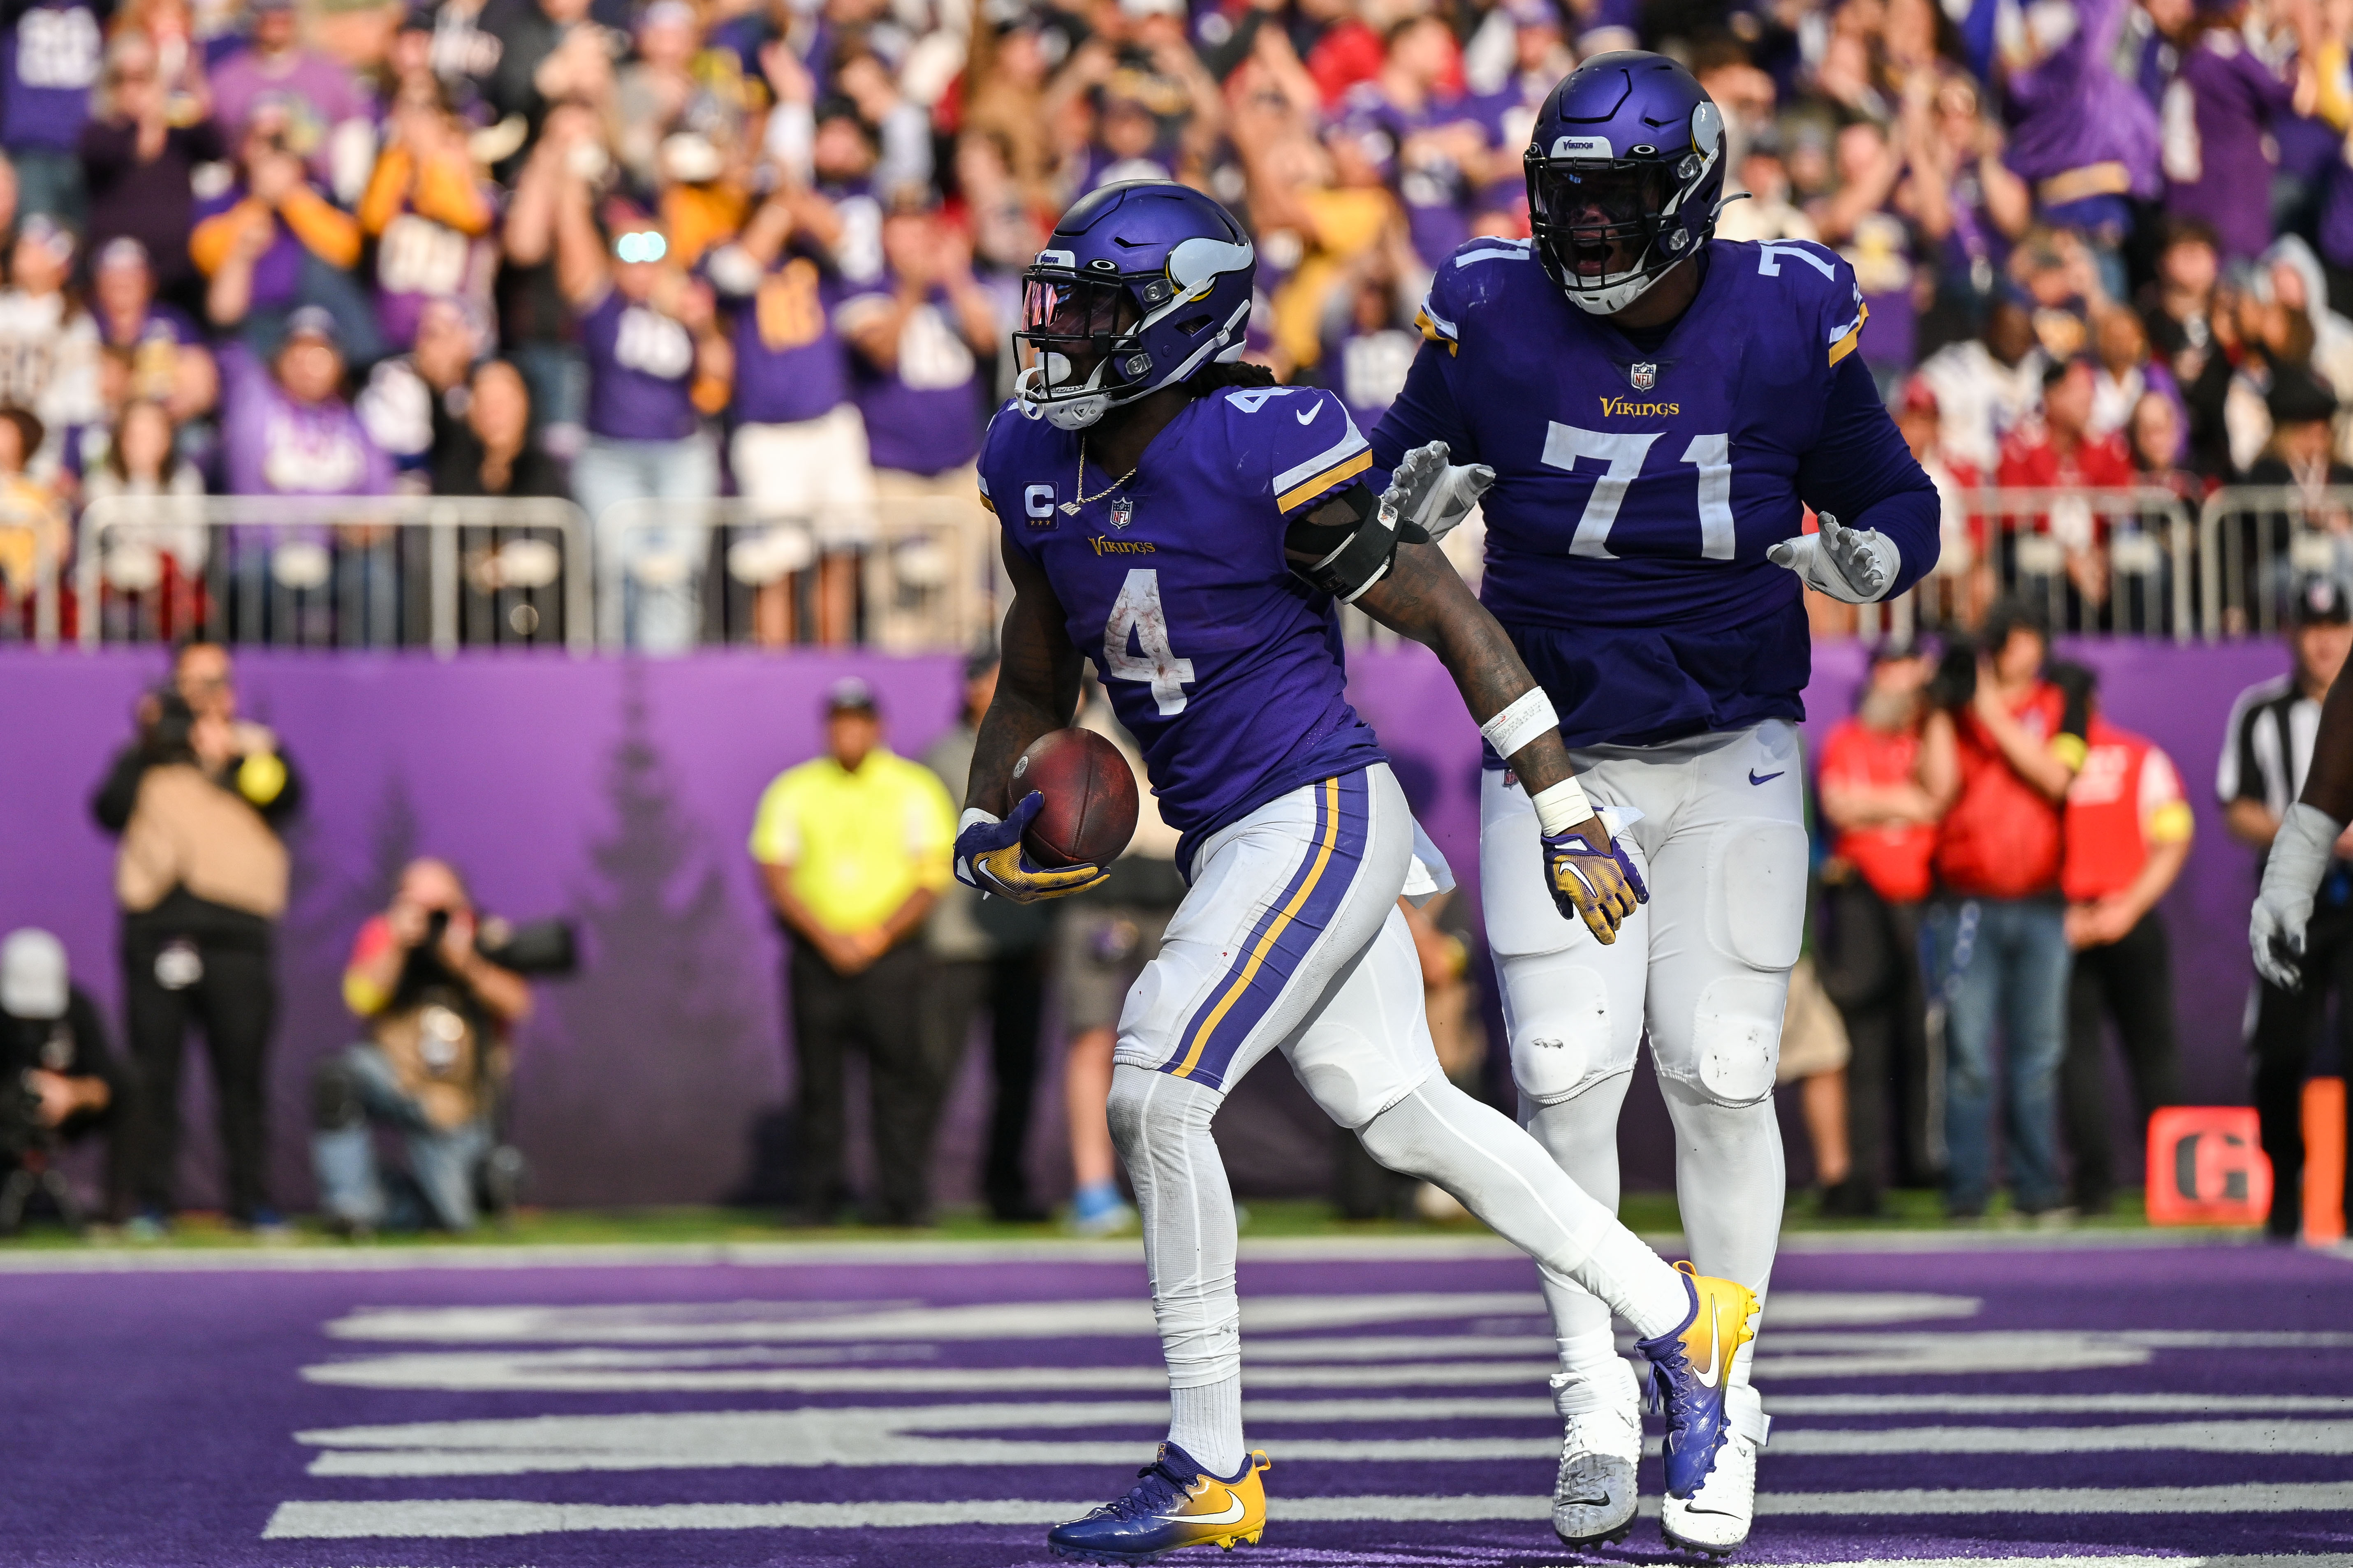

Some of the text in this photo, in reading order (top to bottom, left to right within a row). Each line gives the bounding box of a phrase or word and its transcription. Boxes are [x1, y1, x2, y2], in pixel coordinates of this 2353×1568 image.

[1635, 375, 1651, 386] NFL
[1224, 387, 1295, 413] 4
[1025, 484, 1054, 518] C
[1540, 421, 1735, 560] 71
[1113, 511, 1128, 523] NFL
[1103, 569, 1195, 715] 4
[2176, 1133, 2249, 1201] G
[1158, 1443, 1166, 1461] DC3
